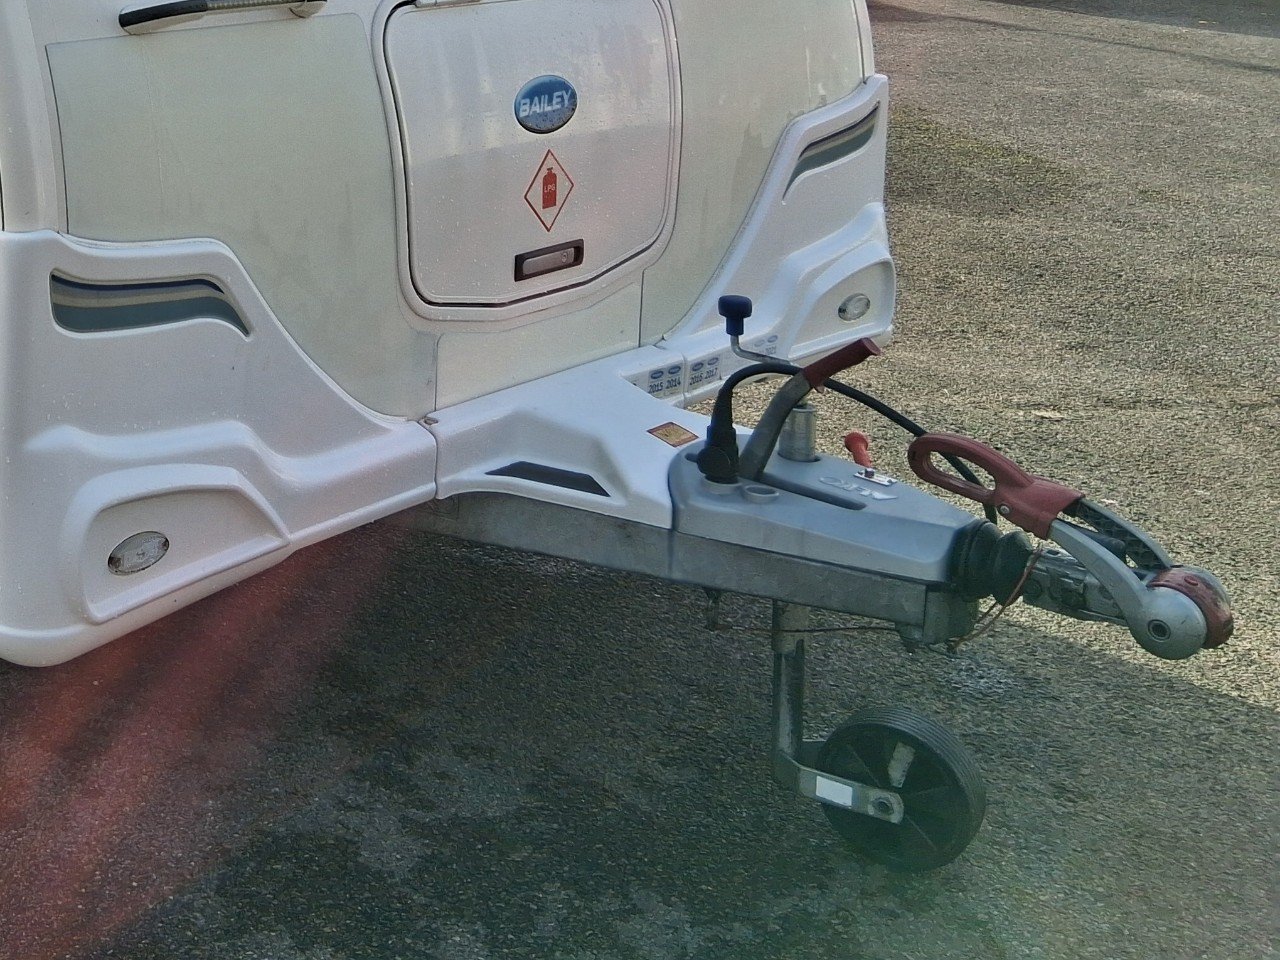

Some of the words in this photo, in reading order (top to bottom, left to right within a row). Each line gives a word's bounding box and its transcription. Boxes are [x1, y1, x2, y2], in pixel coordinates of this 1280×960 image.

[519, 88, 572, 118] BAILEY
[544, 183, 556, 193] LPG
[648, 381, 663, 394] 2015
